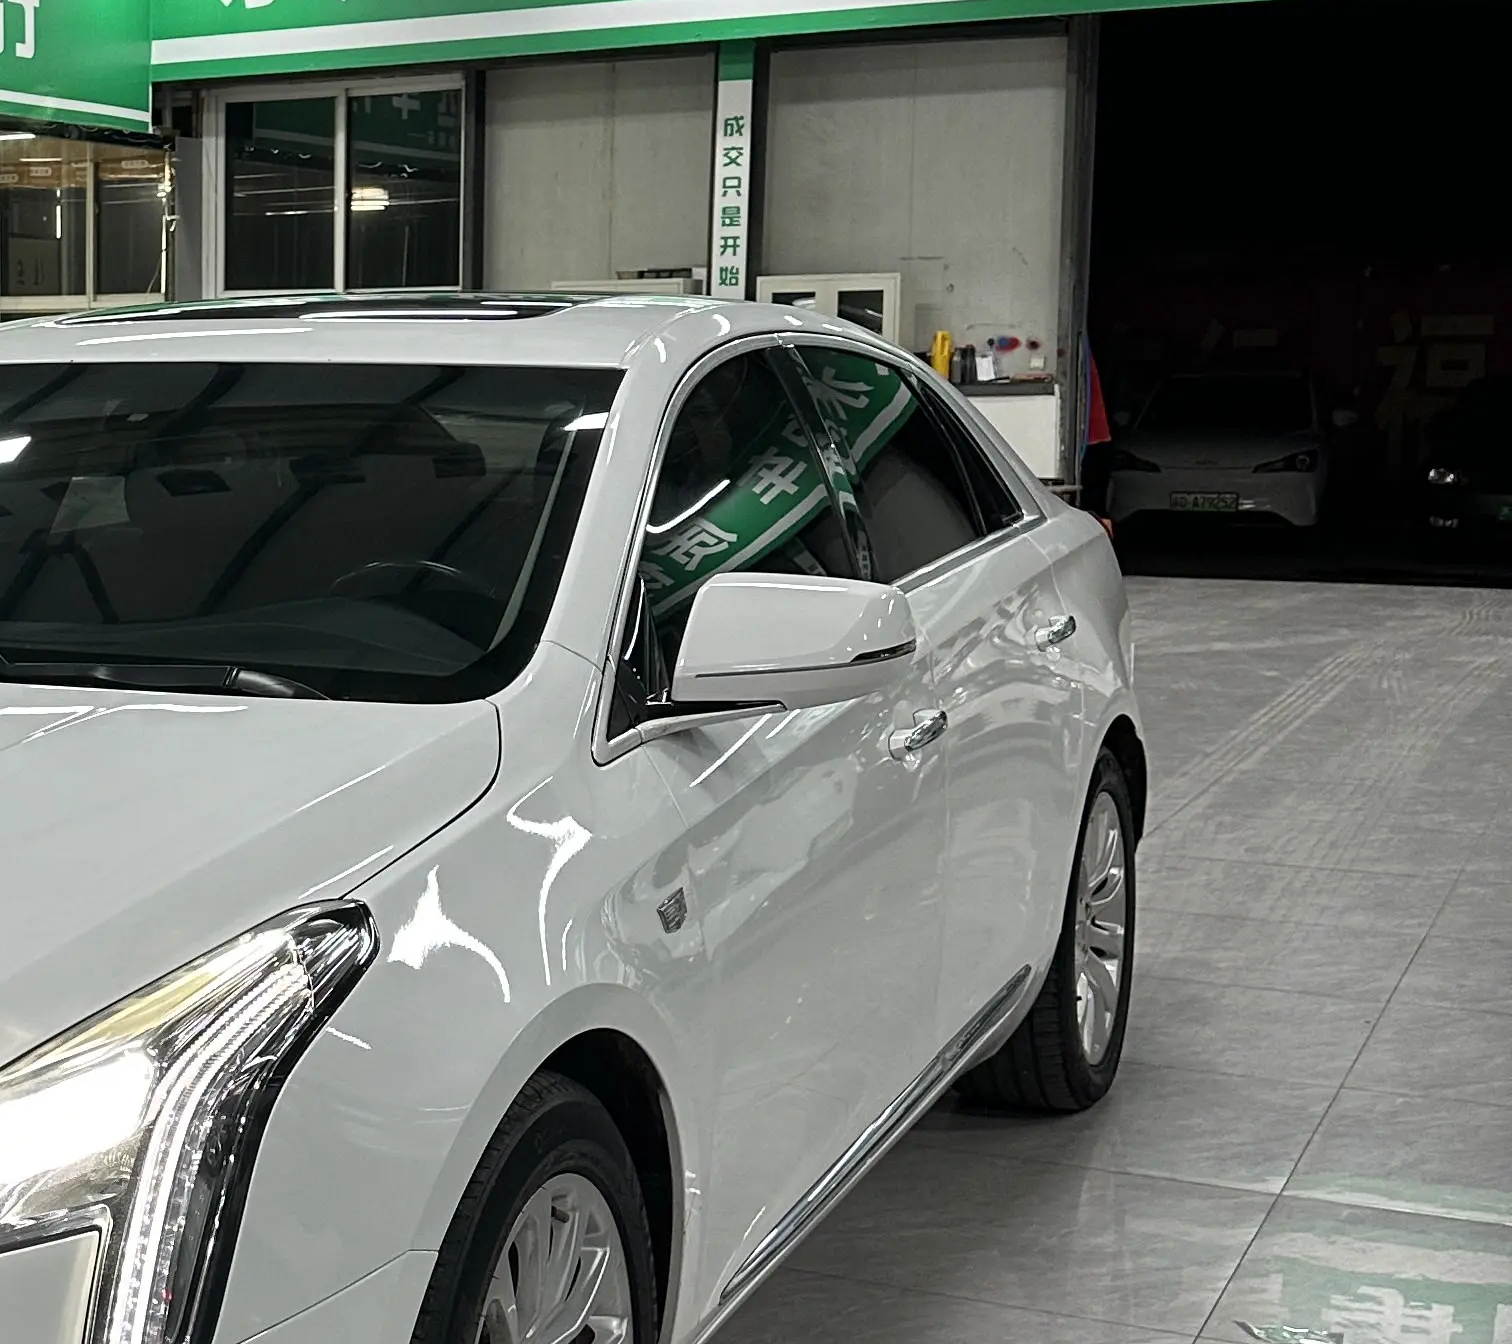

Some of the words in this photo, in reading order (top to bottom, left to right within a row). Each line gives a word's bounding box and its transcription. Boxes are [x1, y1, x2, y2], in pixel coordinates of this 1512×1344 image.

[718, 114, 745, 287] 成交只是开始
